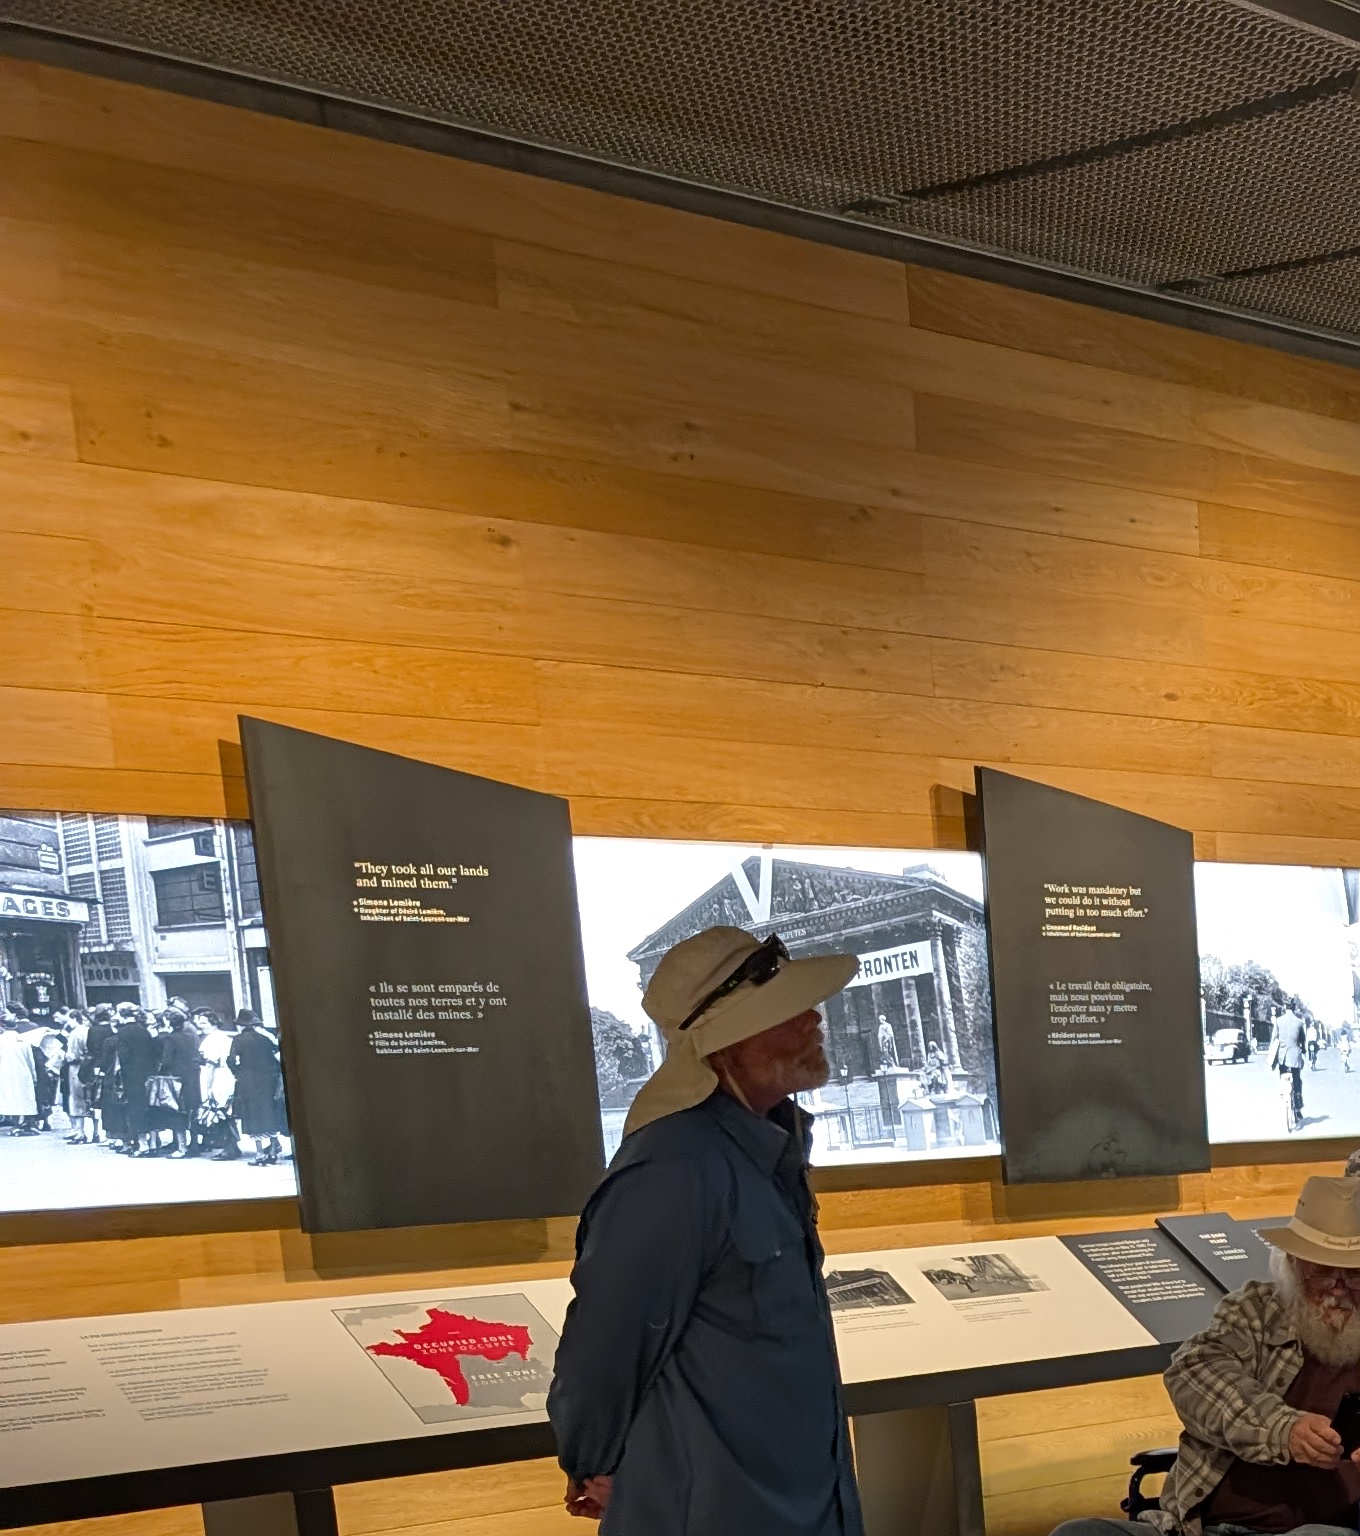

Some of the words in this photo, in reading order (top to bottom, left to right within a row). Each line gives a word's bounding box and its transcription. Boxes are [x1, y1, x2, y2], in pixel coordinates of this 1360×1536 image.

[392, 863, 417, 874] took
[420, 864, 434, 875] all
[438, 866, 457, 875] our
[460, 865, 489, 876] lands
[356, 877, 377, 887] and
[381, 877, 417, 888] mined
[1089, 886, 1127, 897] mandatory
[1129, 886, 1141, 895] but
[1059, 896, 1080, 904] could
[1082, 896, 1092, 905] do
[1094, 897, 1100, 905] it
[1102, 897, 1131, 906] without
[3, 896, 71, 918] AGES
[1046, 907, 1074, 918] putting
[1077, 907, 1084, 916] in
[1087, 908, 1099, 916] too
[1101, 908, 1121, 917] much
[857, 949, 920, 980] FRONTEN
[380, 982, 393, 993] Ils
[397, 985, 408, 993] se
[412, 984, 435, 992] sont
[439, 982, 483, 995] emparés
[486, 982, 499, 992] de
[1057, 982, 1066, 990] Le
[1068, 981, 1092, 990] travail
[1094, 981, 1110, 990] était
[371, 998, 405, 1006] toutes
[432, 998, 462, 1006] terres
[479, 998, 485, 1008] y
[1050, 993, 1068, 1001] mais
[1091, 992, 1124, 1003] pouvions
[372, 1009, 413, 1020] installé
[417, 1009, 435, 1019] des
[438, 1010, 473, 1019] mines.
[1107, 1005, 1112, 1014] y
[1051, 1016, 1067, 1026] trop
